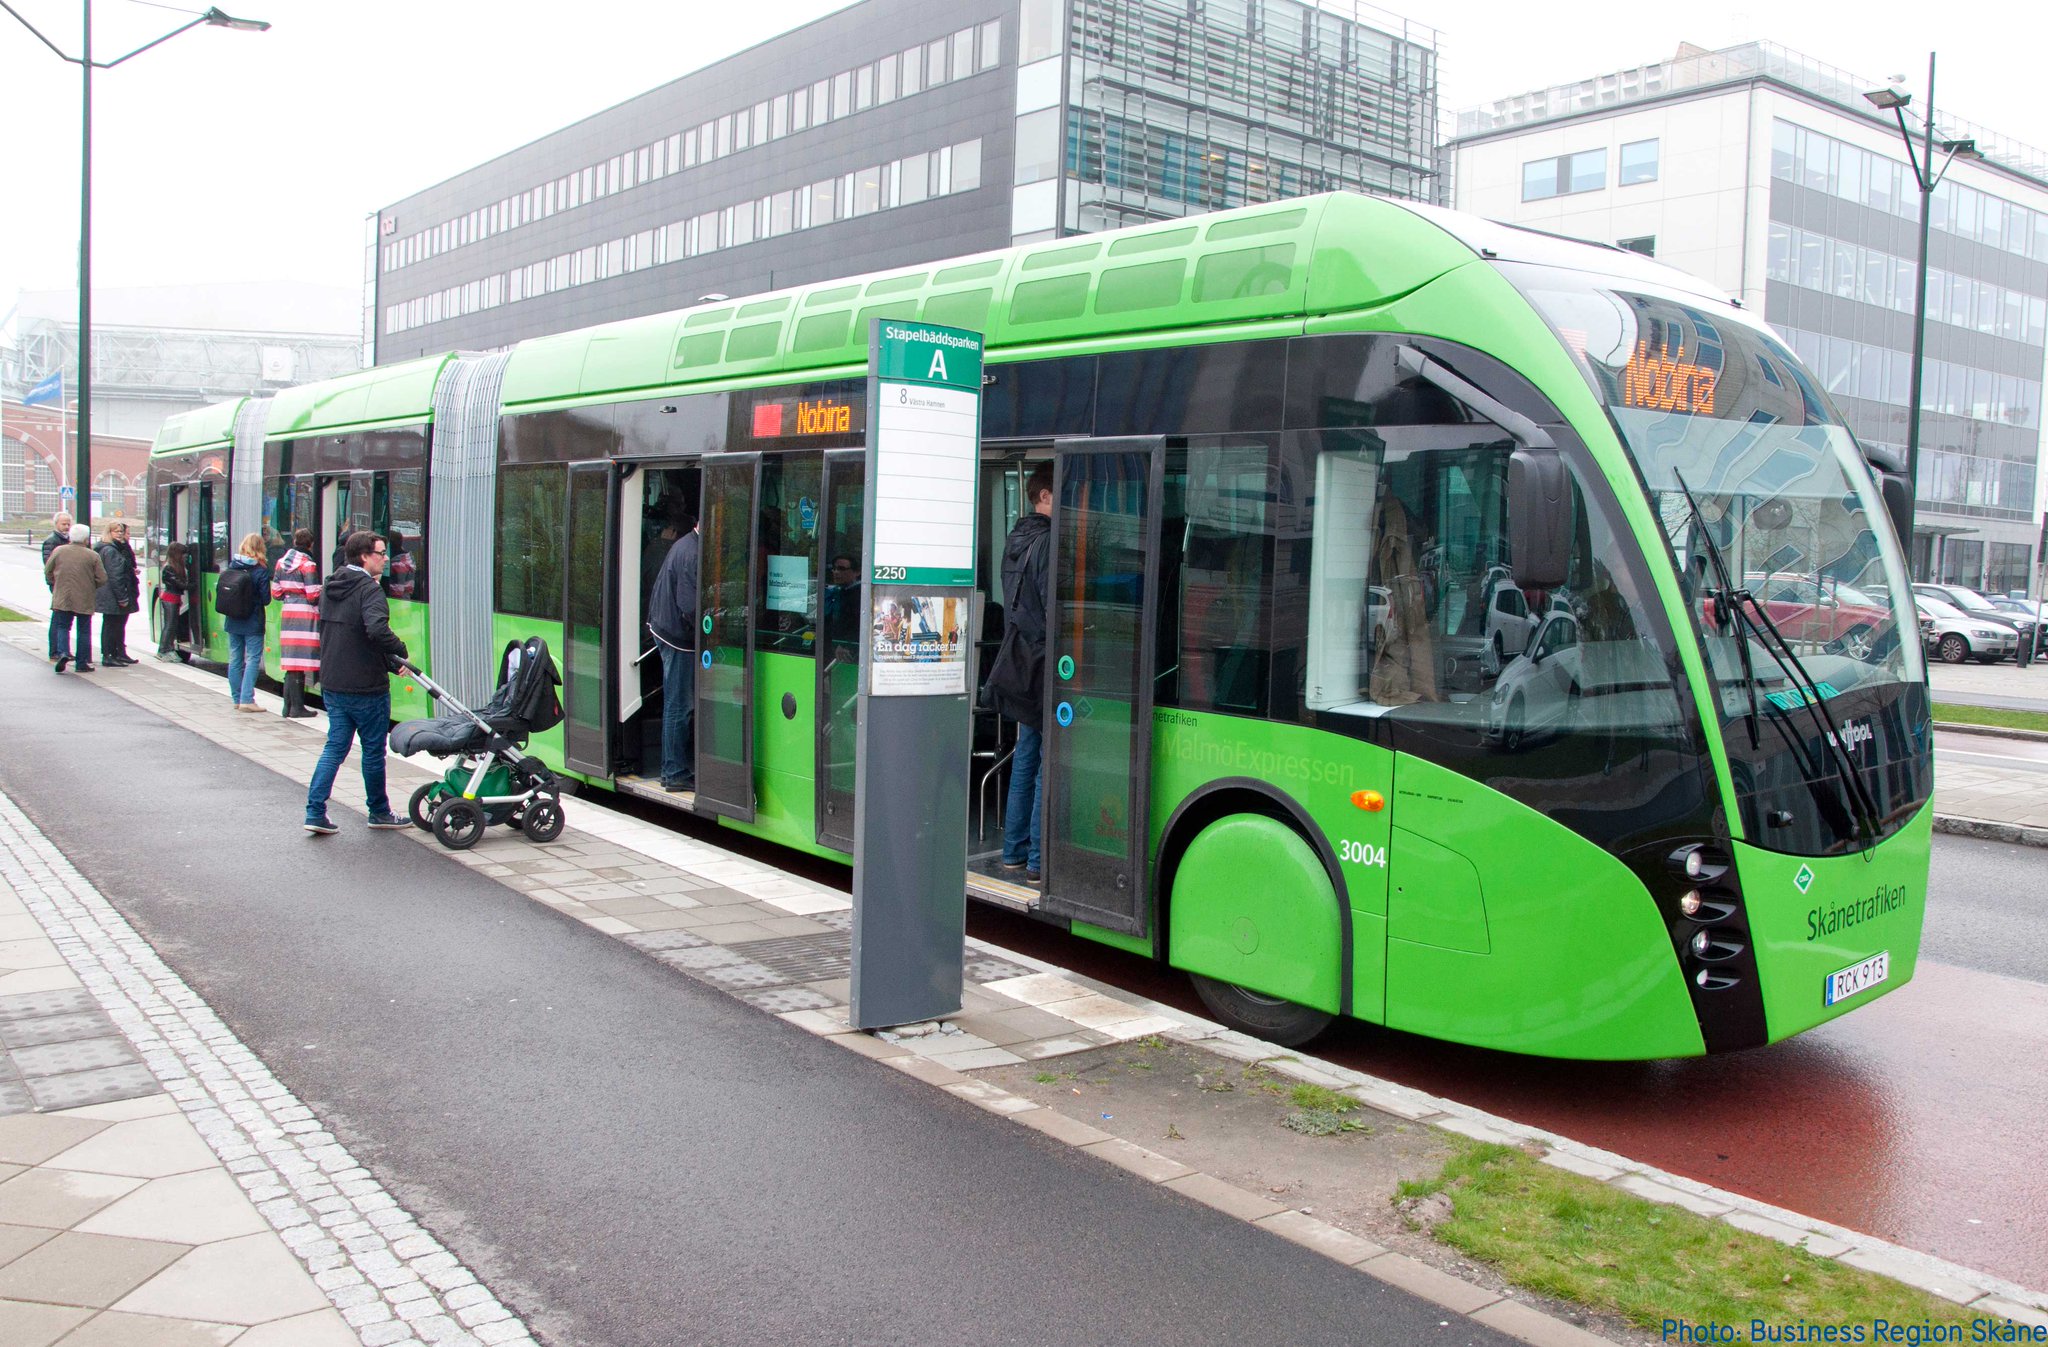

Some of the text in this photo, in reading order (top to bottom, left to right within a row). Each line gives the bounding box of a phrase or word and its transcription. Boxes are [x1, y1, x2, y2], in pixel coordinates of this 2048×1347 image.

[886, 326, 979, 351] Stapelbäddsparken
[927, 349, 948, 380] A
[1625, 338, 1715, 414] Nobina
[900, 388, 907, 405] 8
[797, 399, 850, 434] Nobina
[874, 566, 906, 580] z250
[877, 641, 892, 652] En
[894, 641, 917, 654] dag
[919, 640, 948, 652] räcker
[1162, 729, 1355, 787] MalmöExpressen
[1340, 839, 1387, 868] 3004
[1807, 884, 1906, 941] Skånetrafiken
[1837, 969, 1858, 998] RCK
[1863, 957, 1884, 986] 913
